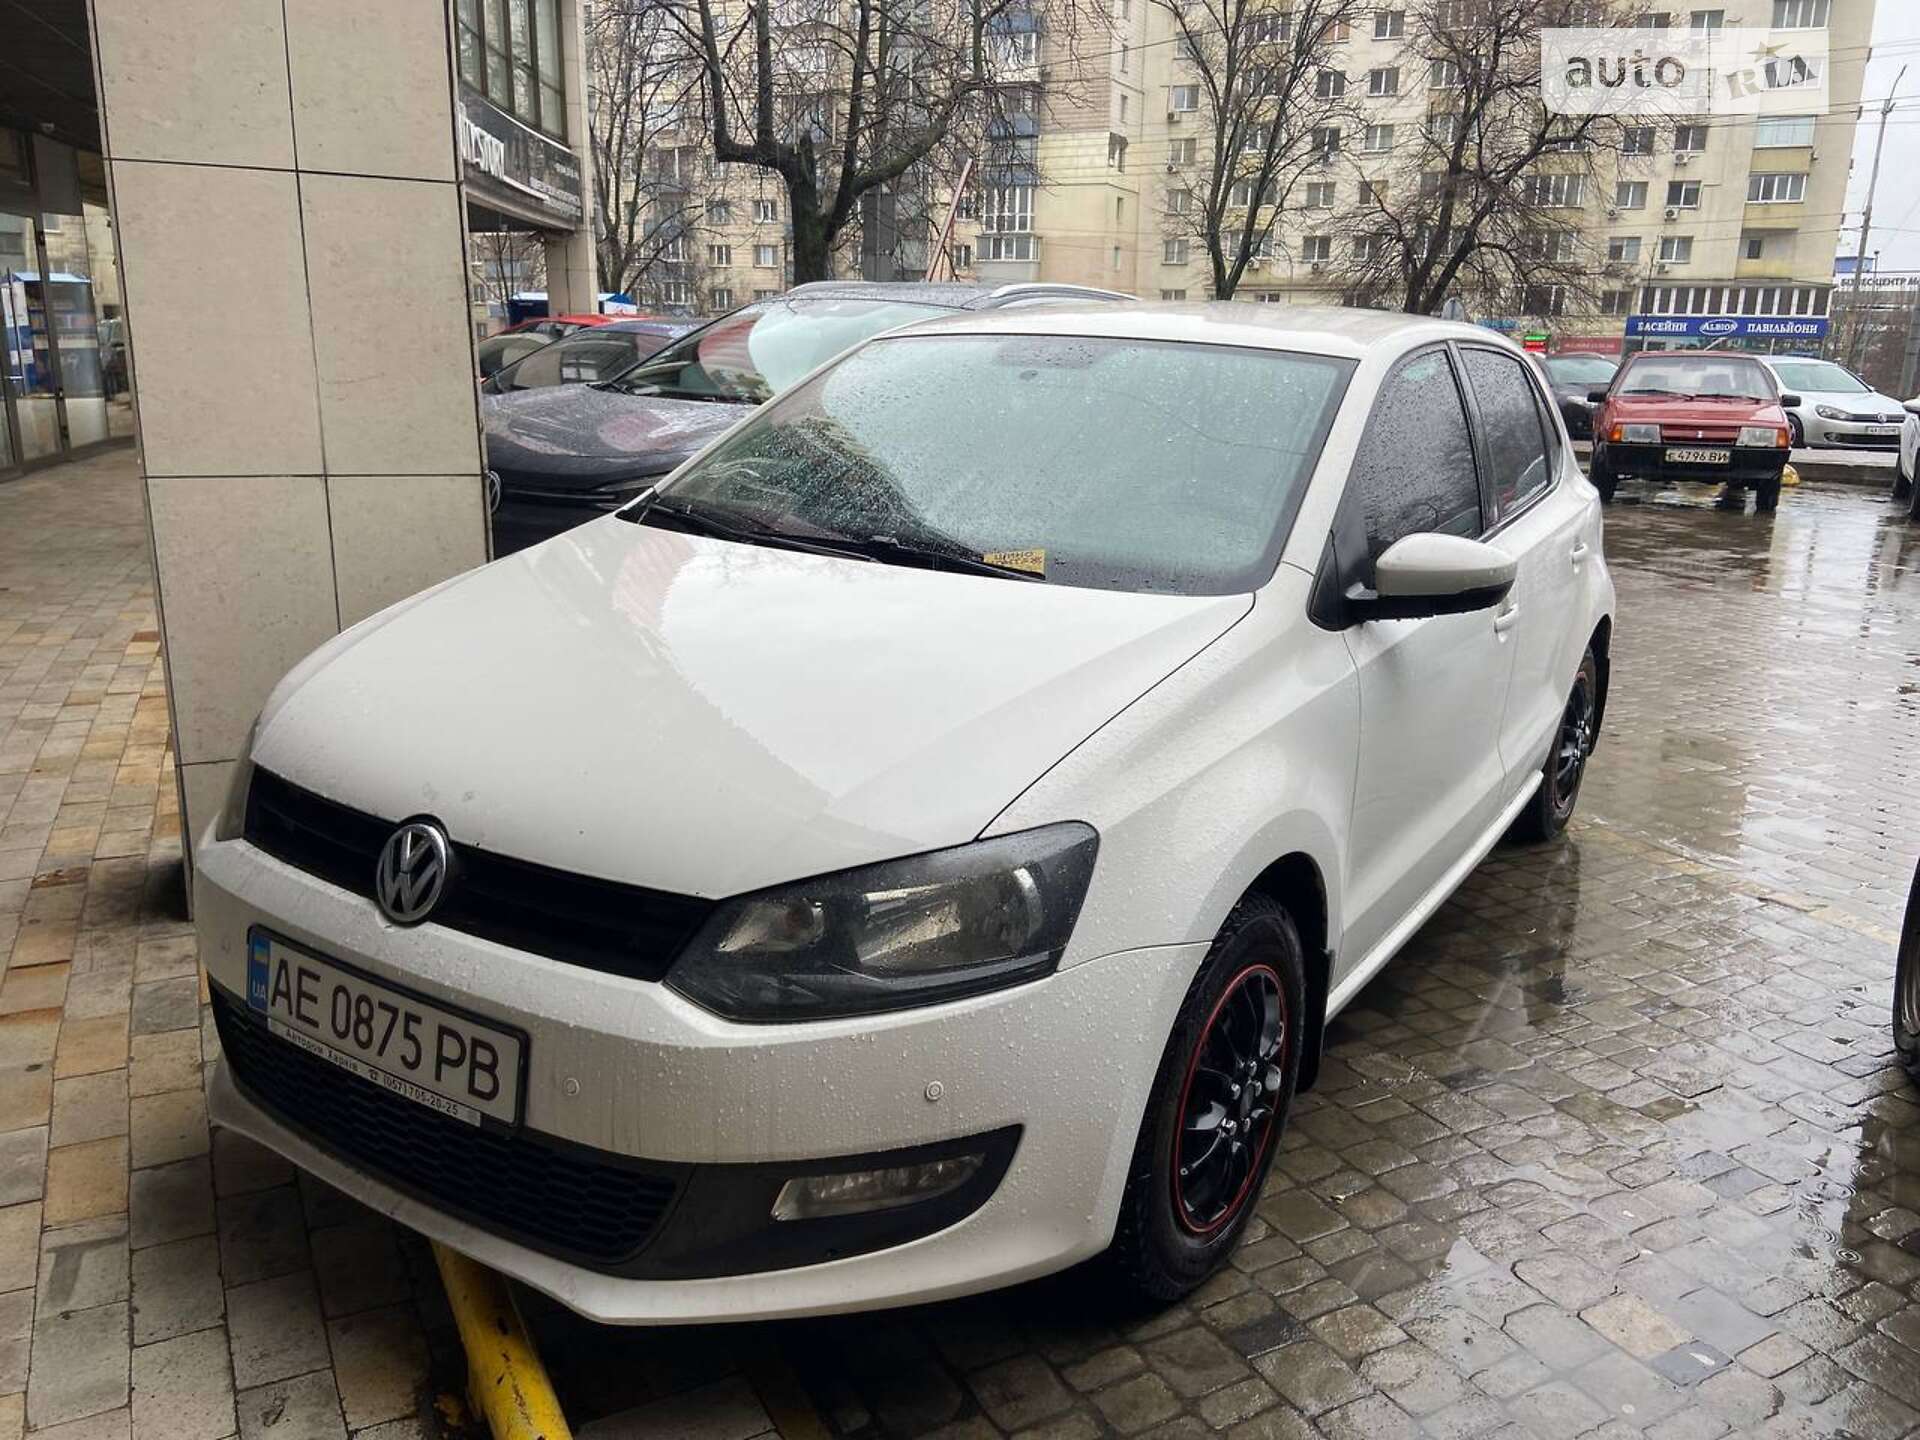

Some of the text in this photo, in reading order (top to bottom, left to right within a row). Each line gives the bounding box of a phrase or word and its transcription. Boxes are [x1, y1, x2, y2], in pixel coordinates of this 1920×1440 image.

[1637, 320, 1687, 332] БАСЕЙНИ
[1747, 322, 1818, 334] ПАВІЛЬЙОНИ
[252, 982, 267, 1000] UA
[271, 958, 501, 1101] AE 0875 PB
